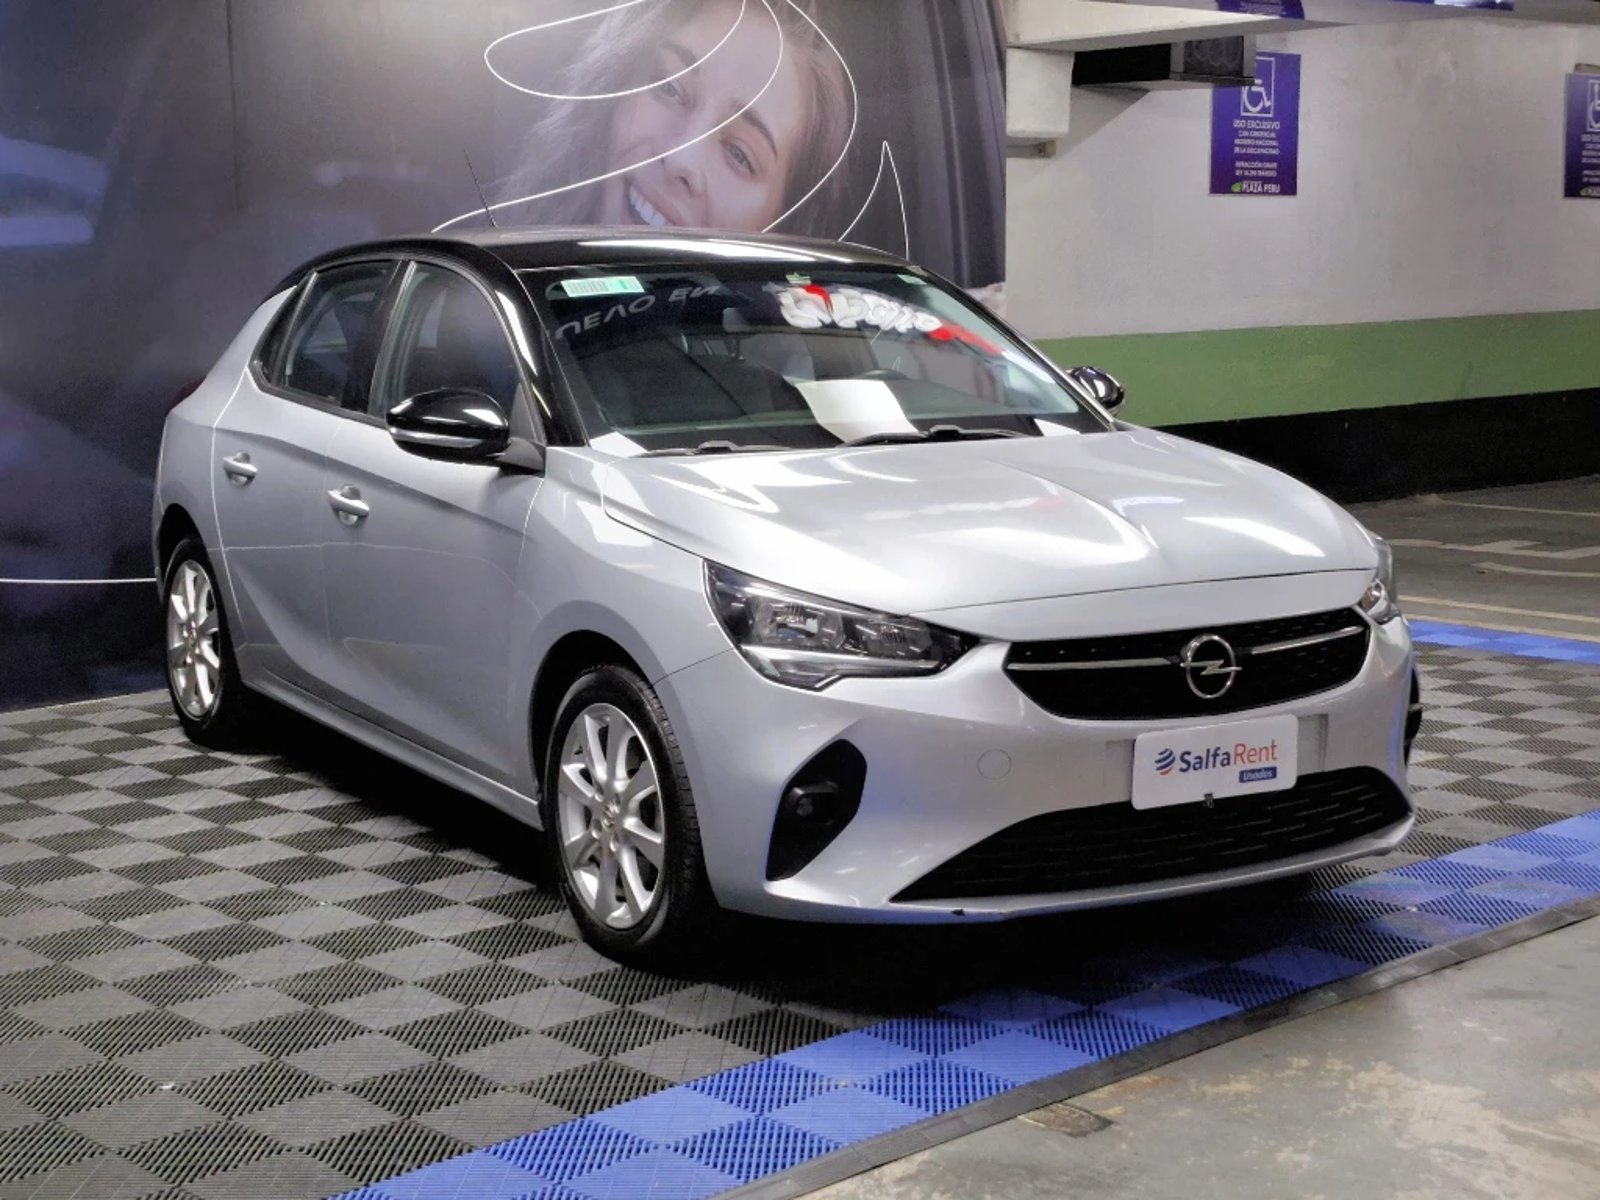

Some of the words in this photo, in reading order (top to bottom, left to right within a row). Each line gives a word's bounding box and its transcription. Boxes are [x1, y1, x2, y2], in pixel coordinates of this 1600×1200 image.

[1233, 119, 1246, 128] USO
[1247, 120, 1281, 130] EXCLUSIVO
[1242, 183, 1263, 193] PLAZA
[1242, 767, 1273, 781] Usados
